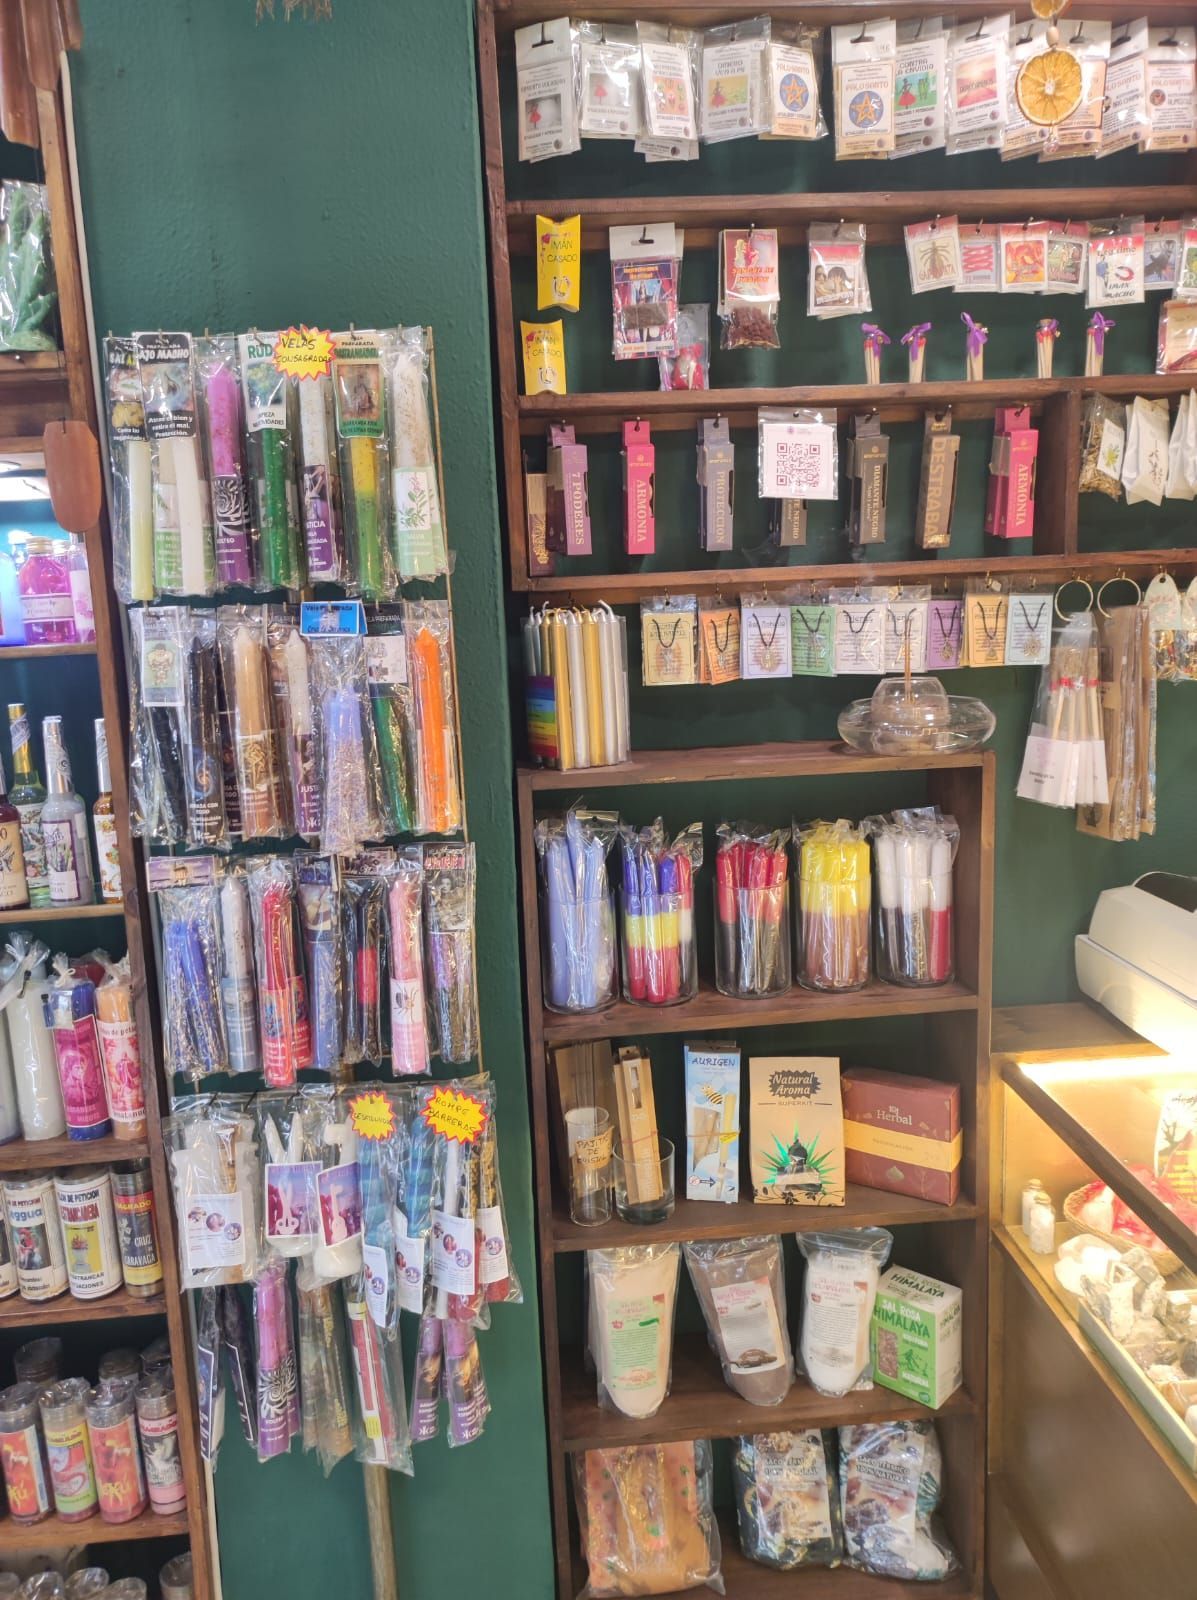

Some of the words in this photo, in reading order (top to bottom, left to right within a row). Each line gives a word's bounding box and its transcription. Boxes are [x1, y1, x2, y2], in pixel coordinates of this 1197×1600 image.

[247, 344, 273, 359] RUD
[281, 337, 317, 350] VELAS
[872, 465, 881, 508] DIAMANTE
[1015, 463, 1030, 526] ARMONIA
[572, 482, 585, 545] PODERES
[636, 479, 647, 543] ARMONIA
[715, 471, 727, 544] PROTECCION
[871, 510, 880, 538] NEGRO
[692, 1057, 735, 1067] AURIGEN
[772, 1072, 814, 1084] Natural
[775, 1085, 811, 1095] Aroma
[435, 1097, 470, 1115] ROMPE
[876, 1110, 913, 1126] Herbal
[135, 1234, 152, 1247] CRUZ
[892, 1274, 945, 1298] HIMALAYA
[882, 1299, 897, 1313] SAL
[900, 1305, 921, 1321] ROSA
[873, 1304, 930, 1339] HIMALAYA
